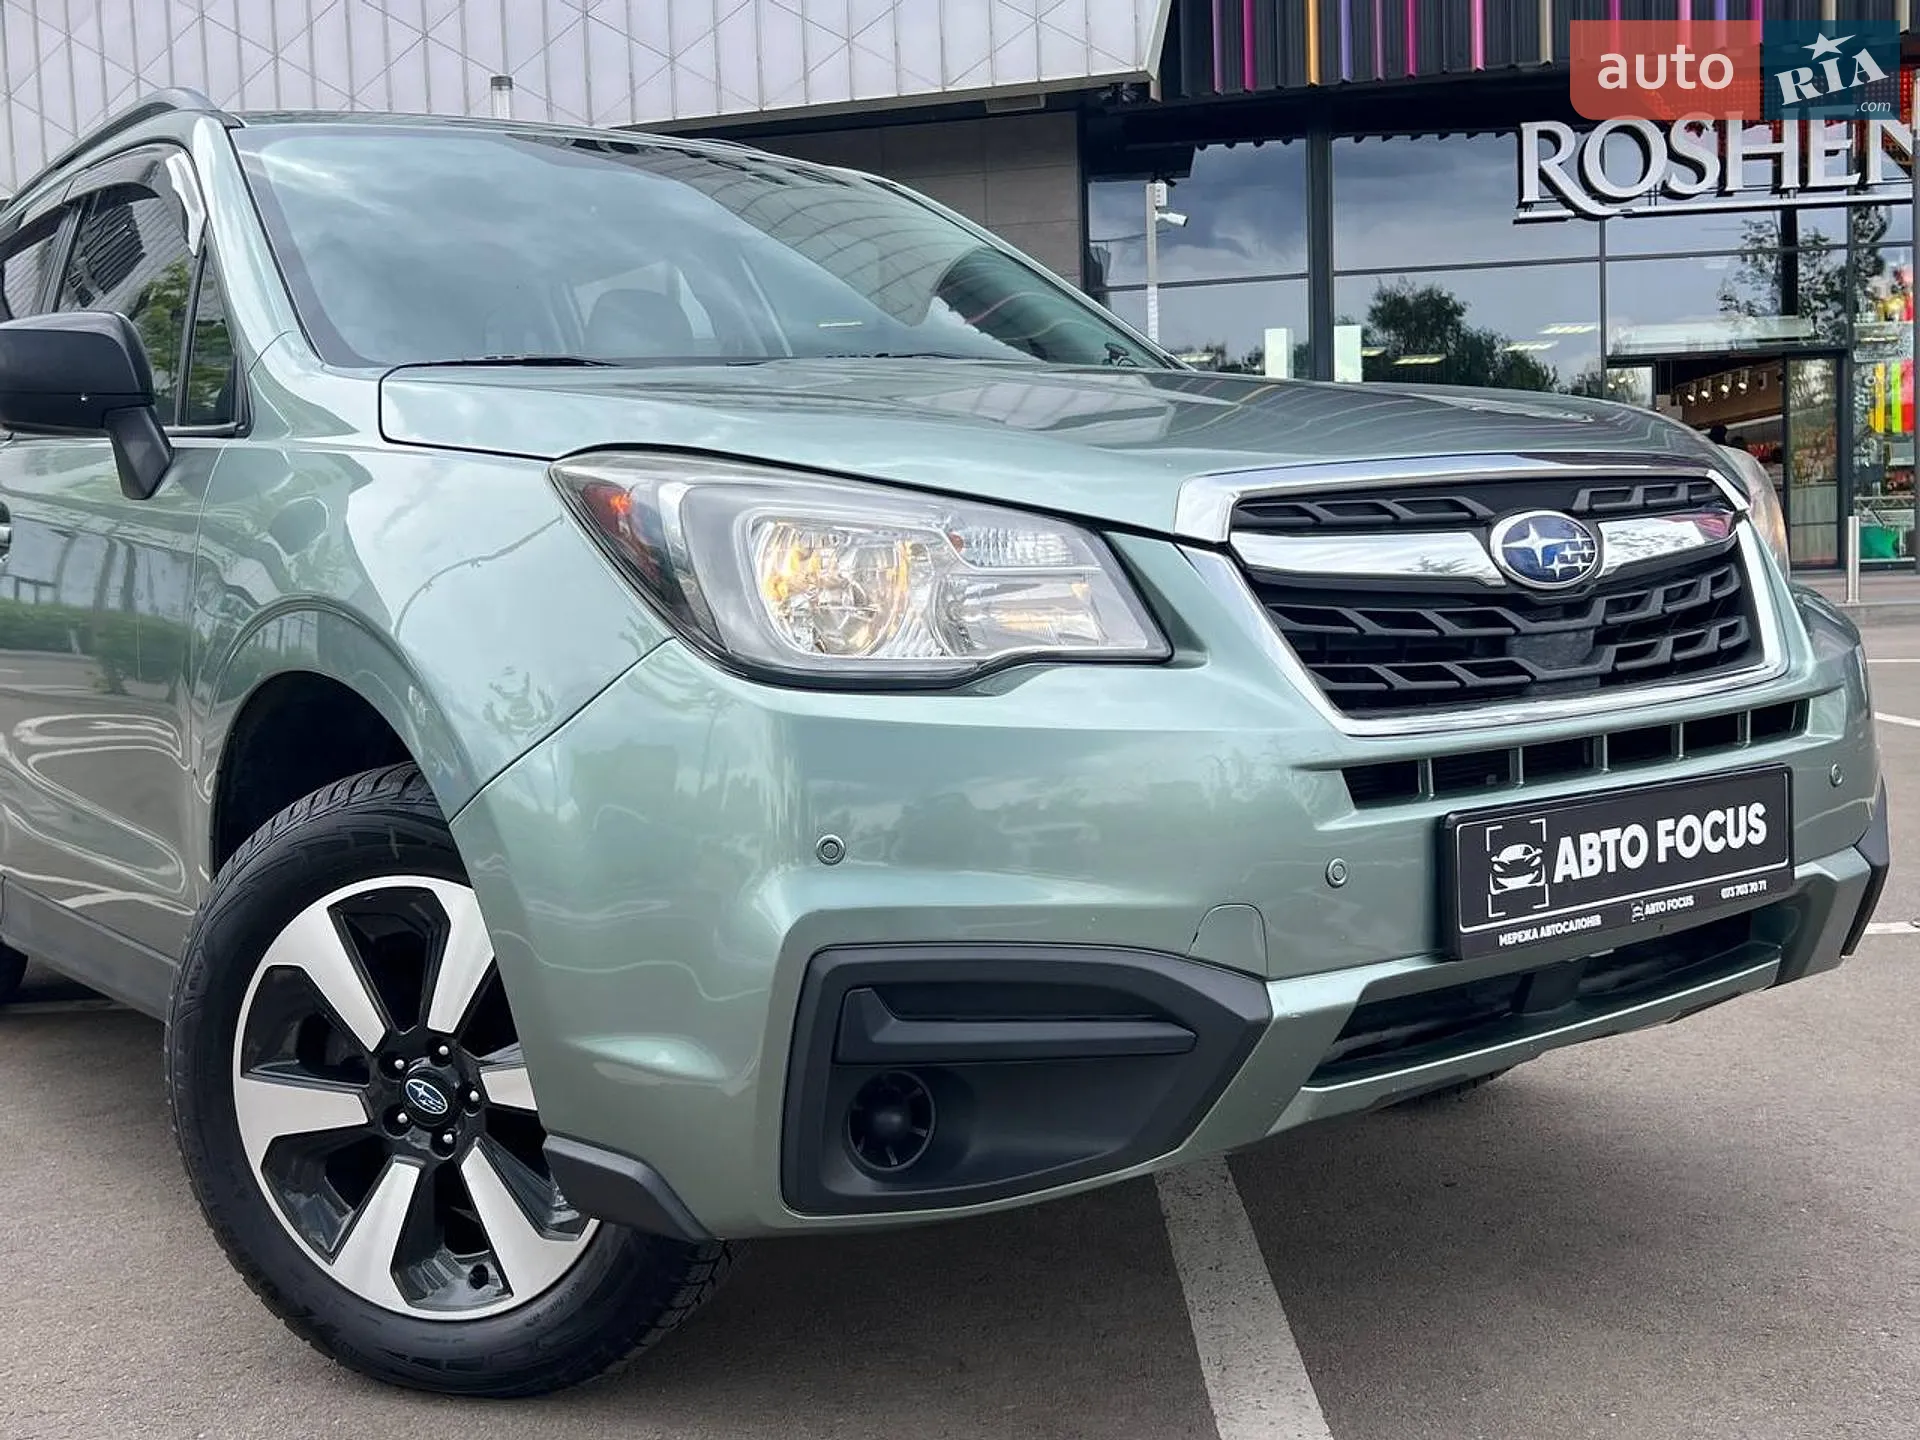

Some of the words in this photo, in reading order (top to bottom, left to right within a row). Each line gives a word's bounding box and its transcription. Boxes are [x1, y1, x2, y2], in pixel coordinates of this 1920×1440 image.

[1552, 823, 1649, 884] АВТО
[1656, 802, 1767, 864] FOCUS
[1666, 895, 1695, 910] FOCUS
[1498, 926, 1539, 947] МЕРЕЖА
